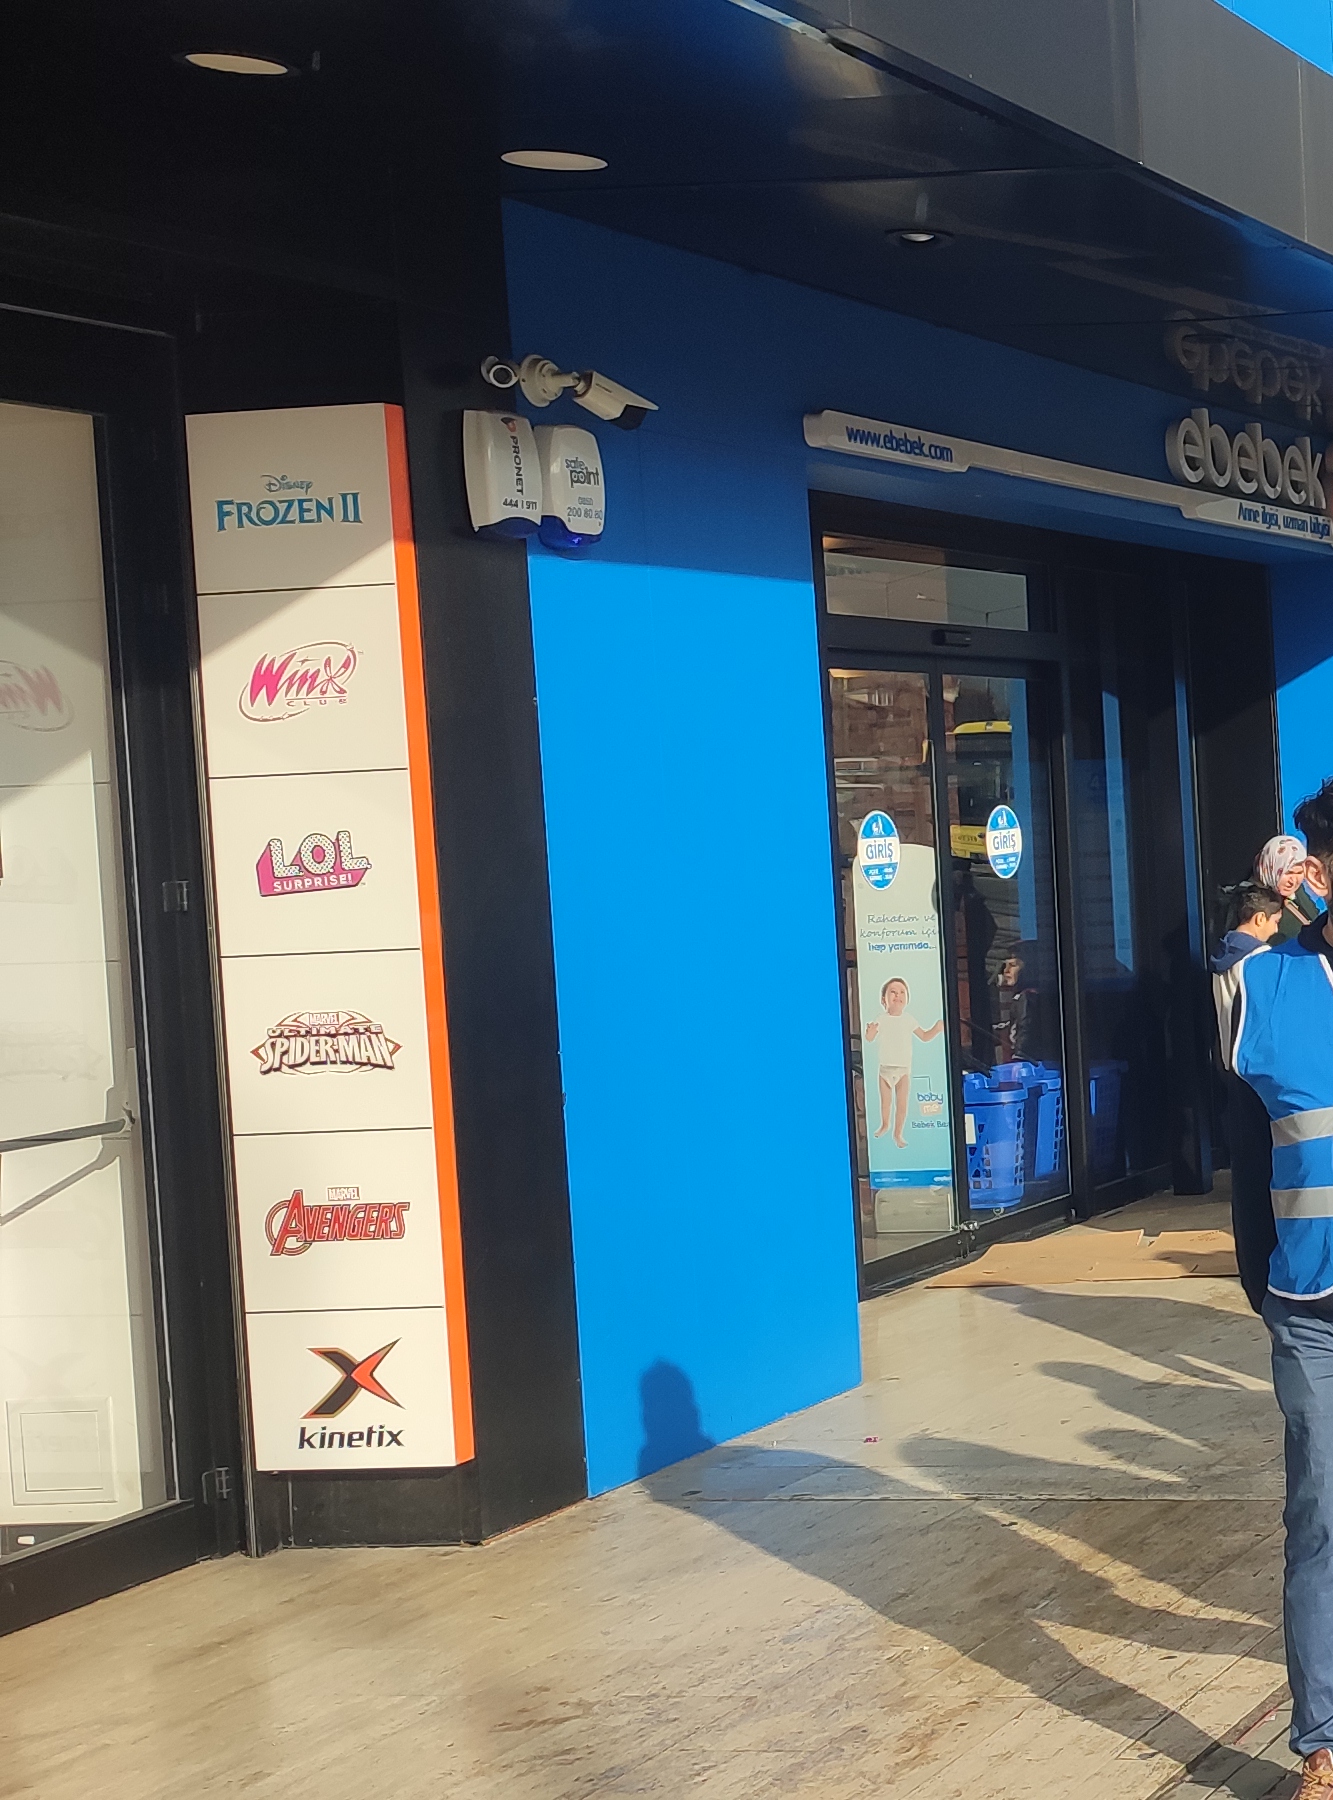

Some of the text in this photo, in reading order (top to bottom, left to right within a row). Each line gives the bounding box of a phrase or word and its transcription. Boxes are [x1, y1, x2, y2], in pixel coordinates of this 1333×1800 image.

[846, 425, 954, 463] www.ebebek.com
[510, 435, 524, 496] PRONET
[1165, 408, 1326, 510] ebebek
[215, 491, 363, 533] FROZEN II
[503, 497, 519, 509] 444
[865, 840, 894, 862] GİRİŞ
[992, 831, 1016, 851] GİRİŞ
[273, 873, 353, 892] SURPRISE!
[267, 1023, 385, 1037] ULTIMATE
[327, 1186, 360, 1201] MARVEL
[270, 1189, 410, 1257] AVENGERS
[298, 1423, 406, 1450] kinetix
